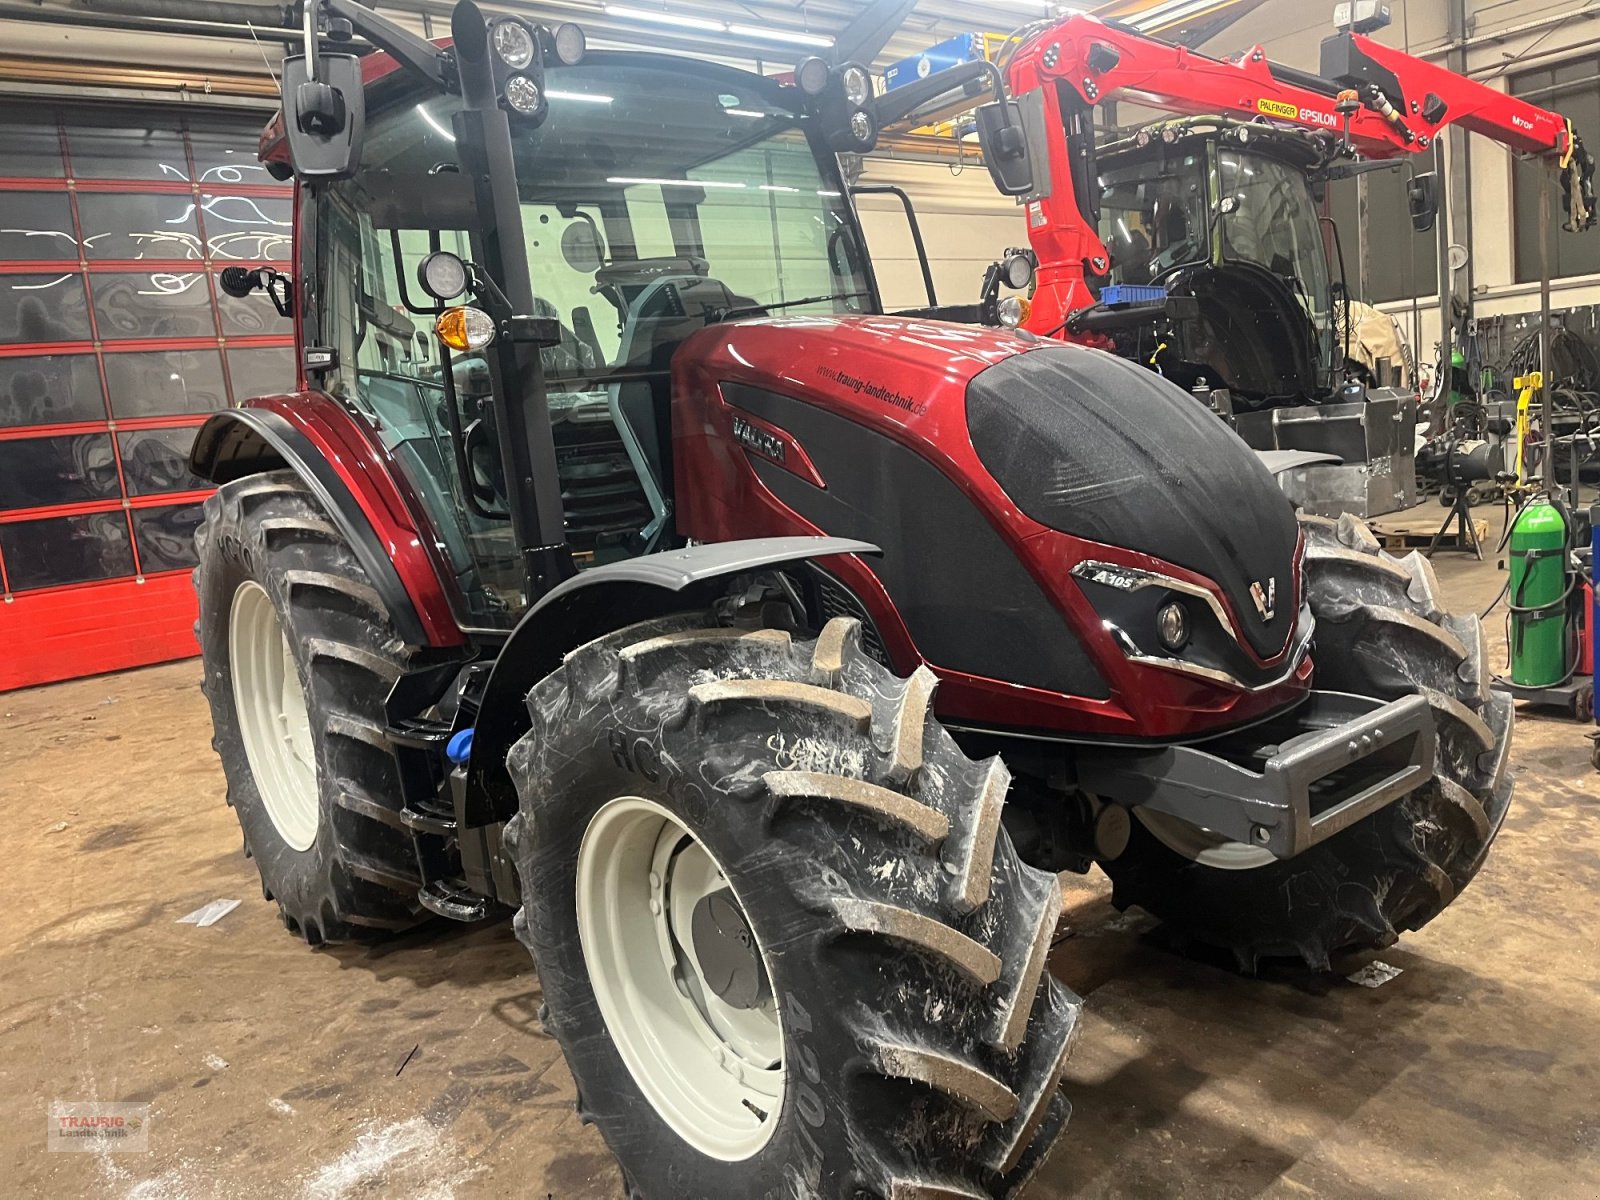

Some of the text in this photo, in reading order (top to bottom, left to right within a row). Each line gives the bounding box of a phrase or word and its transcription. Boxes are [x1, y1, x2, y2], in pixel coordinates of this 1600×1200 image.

[1259, 100, 1337, 127] PALFINGER EPSILON
[816, 364, 927, 417] www.traurig-landtechnik.de
